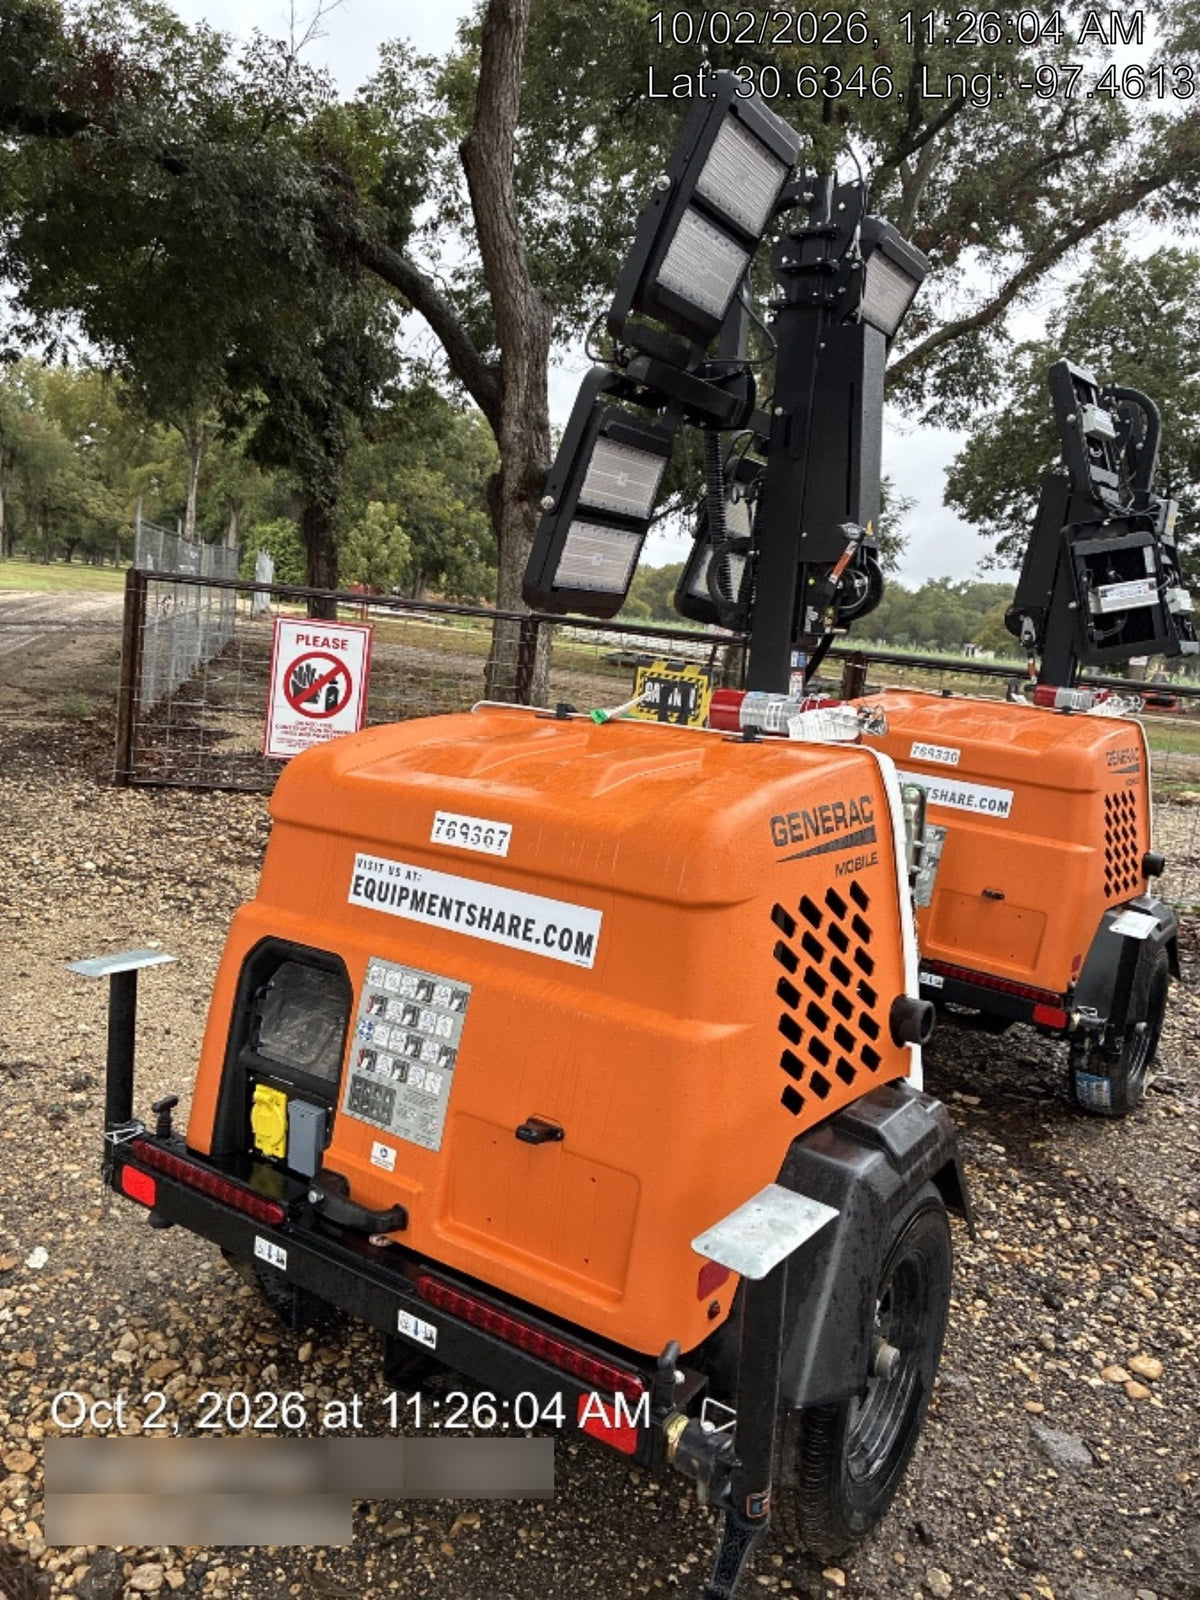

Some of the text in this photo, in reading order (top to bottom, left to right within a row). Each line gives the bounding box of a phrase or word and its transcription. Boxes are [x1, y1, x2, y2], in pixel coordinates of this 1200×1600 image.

[296, 633, 349, 650] PLEASE
[435, 818, 509, 850] 769367
[770, 795, 874, 847] GENERAC
[357, 858, 422, 882] VISIT US AT:
[835, 851, 879, 876] MOBILE
[352, 874, 594, 957] EQUIPMENTSHARE.COM
